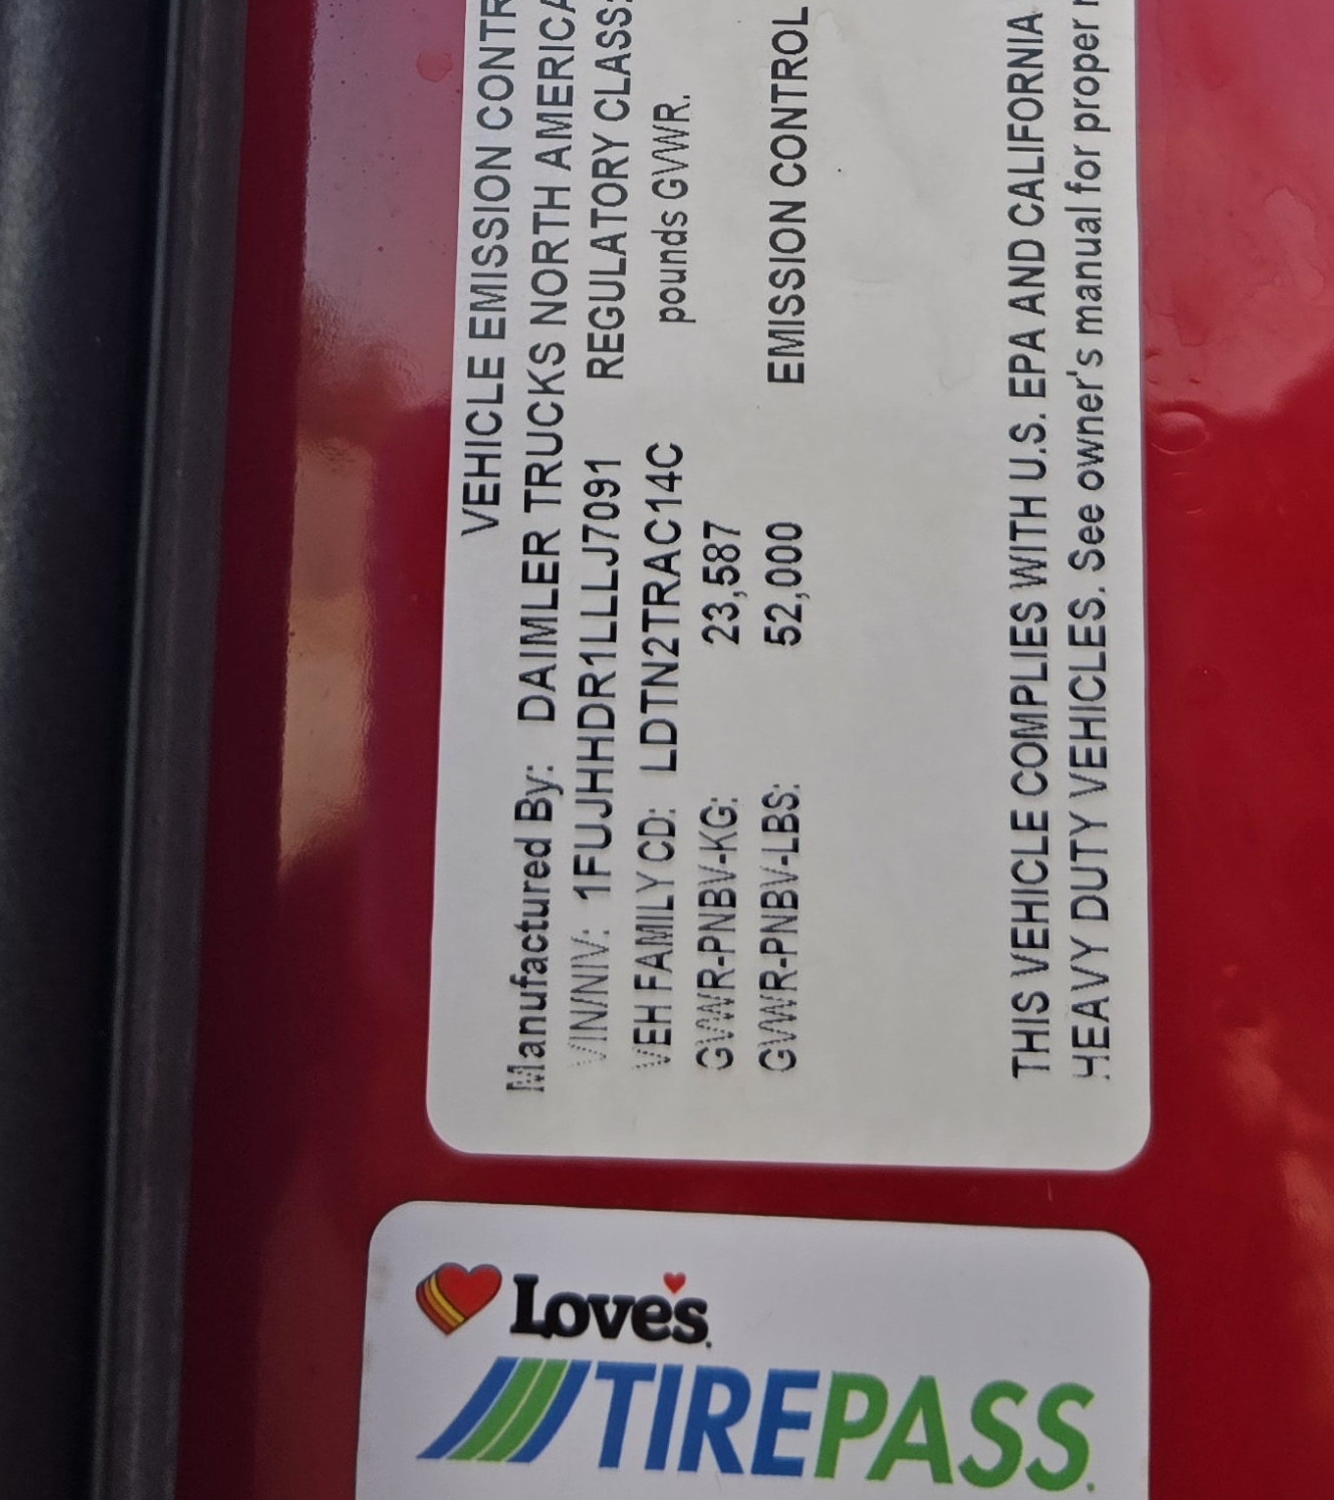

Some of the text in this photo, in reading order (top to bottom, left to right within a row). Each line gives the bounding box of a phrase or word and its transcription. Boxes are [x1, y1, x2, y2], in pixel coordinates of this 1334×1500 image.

[770, 6, 808, 187] CONTROL
[1006, 11, 1045, 227] CALIFORNIA
[1072, 18, 1111, 132] proper
[469, 147, 512, 340] EMISSION
[651, 95, 696, 323] pounds GVWR.
[1064, 144, 1101, 194] for
[530, 186, 571, 325] NORTH
[586, 132, 629, 380] REGULATORY
[767, 201, 806, 384] EMISSION
[1008, 239, 1046, 317] AND
[1064, 207, 1103, 335] manual
[461, 356, 505, 536] VEHICLE
[524, 342, 566, 513] TRUCKS
[1008, 328, 1046, 398] EPA
[1009, 414, 1047, 481] U.S.
[1066, 348, 1105, 491] owner's
[1009, 496, 1047, 589] WITH
[1068, 504, 1105, 572] See
[517, 529, 561, 722] DAIMLER
[1009, 602, 1048, 797] COMPLIES
[1068, 587, 1107, 799] VEHICLES.
[514, 765, 564, 822] By:
[569, 460, 621, 1065] VIN/NIV: 1FUJHHDR1LLLJ7091
[633, 442, 683, 1069] VEH FAMILY CD: LDTN2TRAC14C
[695, 520, 747, 1071] GVWR-PNBV-KG: 23,587
[758, 522, 810, 1073] GVWR-PNBV-LBS: 52,000
[1010, 809, 1049, 978] VEHICLE
[1069, 811, 1109, 921] DUTY
[506, 837, 552, 1093] Manufactured
[1011, 991, 1050, 1079] THIS
[1070, 936, 1110, 1080] HEAVY
